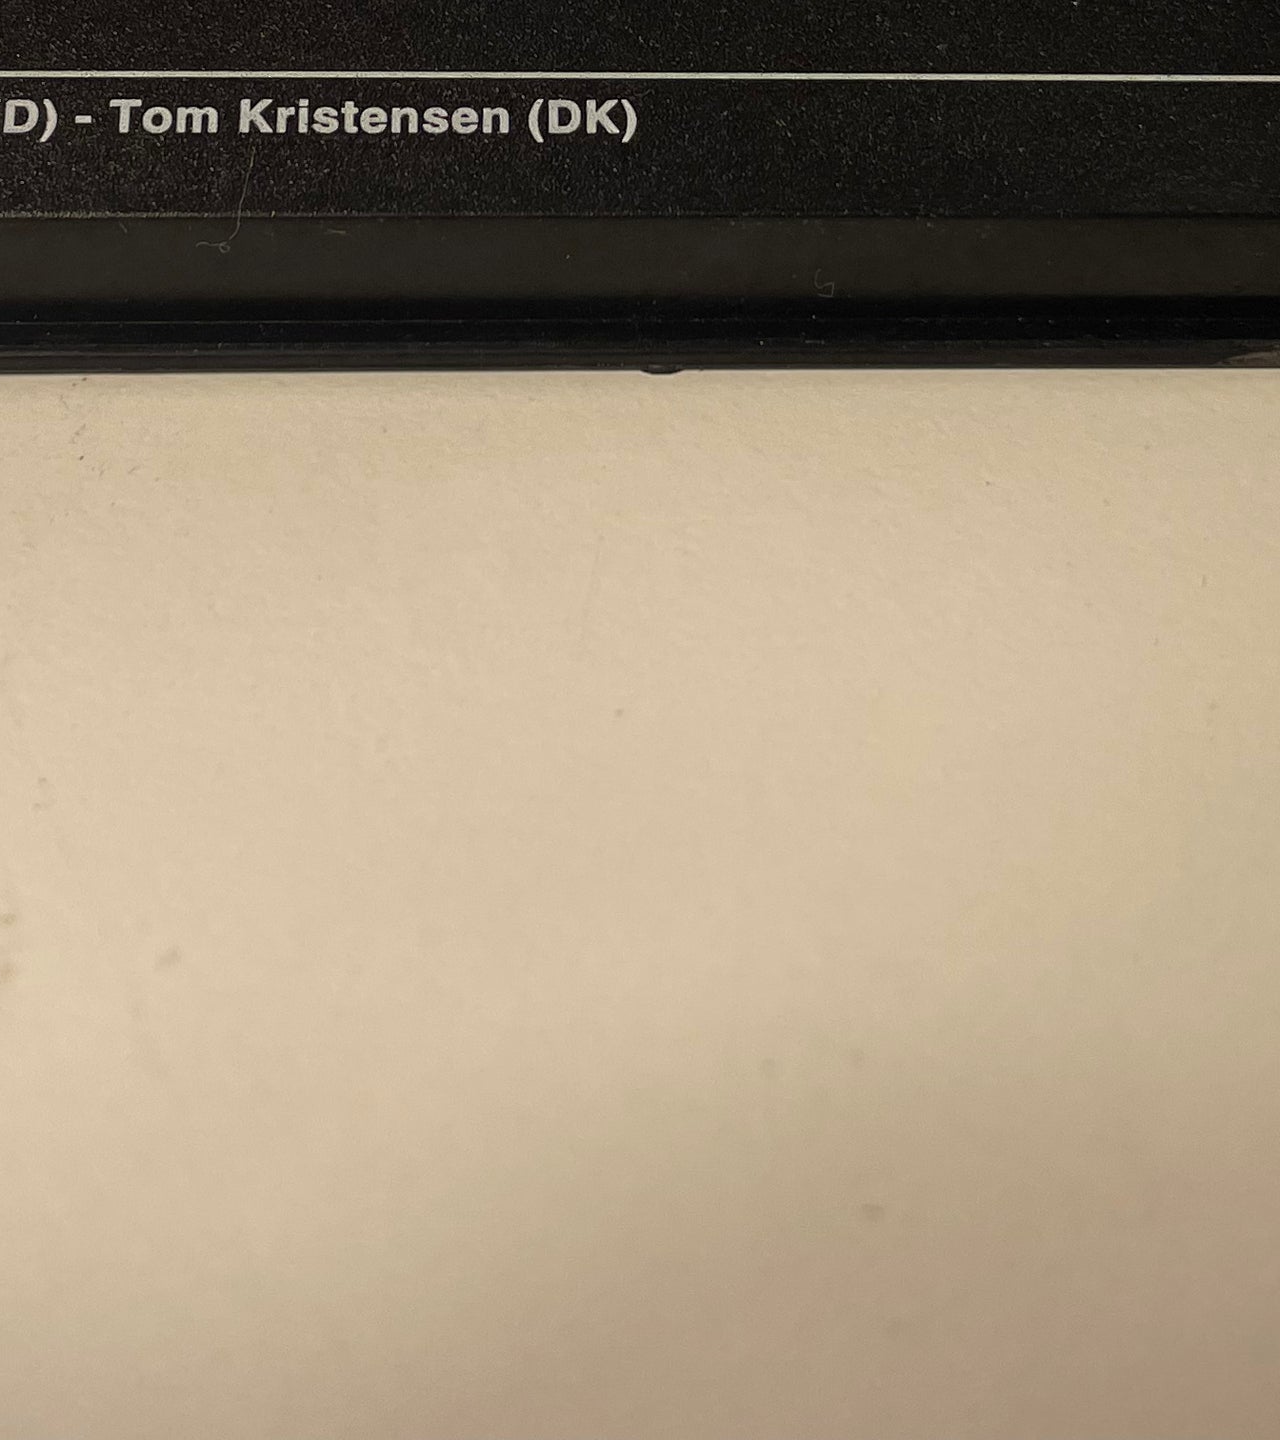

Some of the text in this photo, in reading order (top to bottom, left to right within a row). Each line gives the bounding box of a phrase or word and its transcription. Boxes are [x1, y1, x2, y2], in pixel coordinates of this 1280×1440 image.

[109, 98, 219, 135] Tom
[238, 98, 510, 135] Kristensen
[527, 97, 637, 143] (DK)
